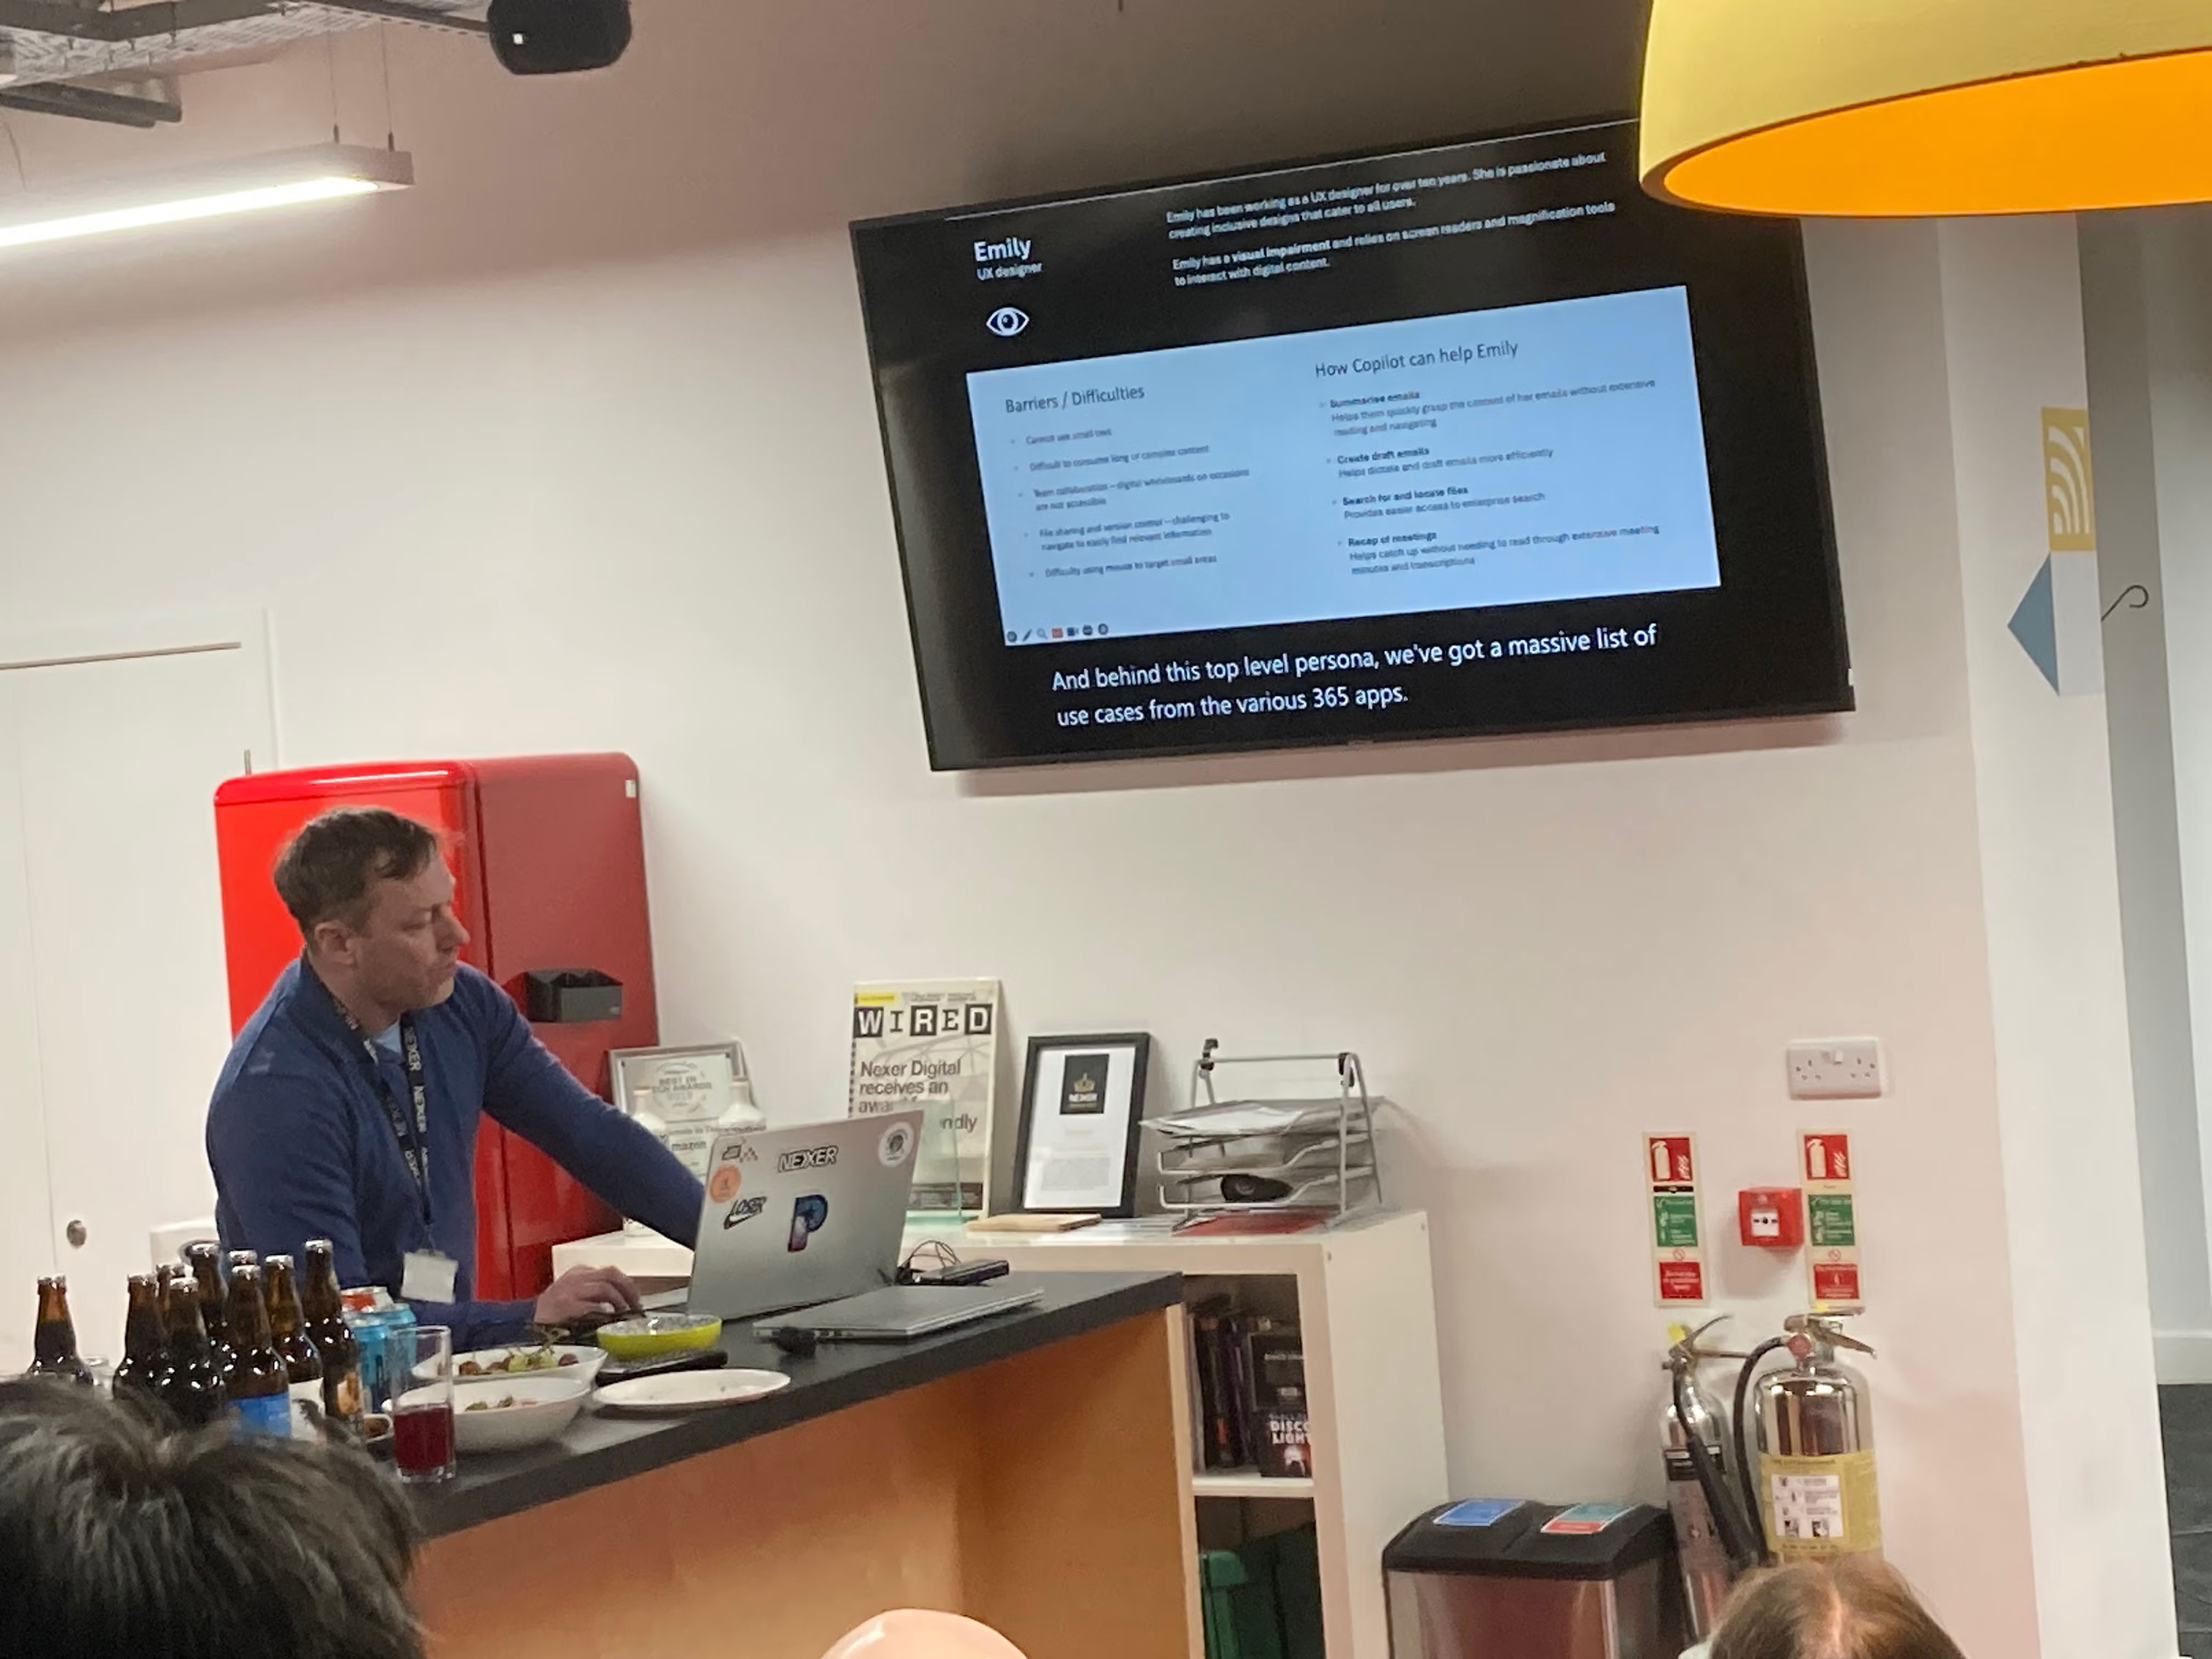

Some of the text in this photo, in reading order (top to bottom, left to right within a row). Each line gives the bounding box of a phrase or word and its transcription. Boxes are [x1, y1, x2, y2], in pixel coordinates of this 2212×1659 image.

[974, 237, 1031, 261] Emily
[1315, 341, 1518, 377] How Copilot can help Emily
[1005, 397, 1058, 413] Barriers
[1071, 387, 1144, 405] Difficulties
[1052, 623, 1656, 691] And behind this top level persona, we've got a massive list of
[1057, 686, 1408, 726] use cases from the various 365 apps.
[853, 1004, 992, 1038] WIRED
[860, 1059, 961, 1080] Nexer Digital
[859, 1081, 949, 1095] receives an
[777, 1145, 839, 1173] NEXER
